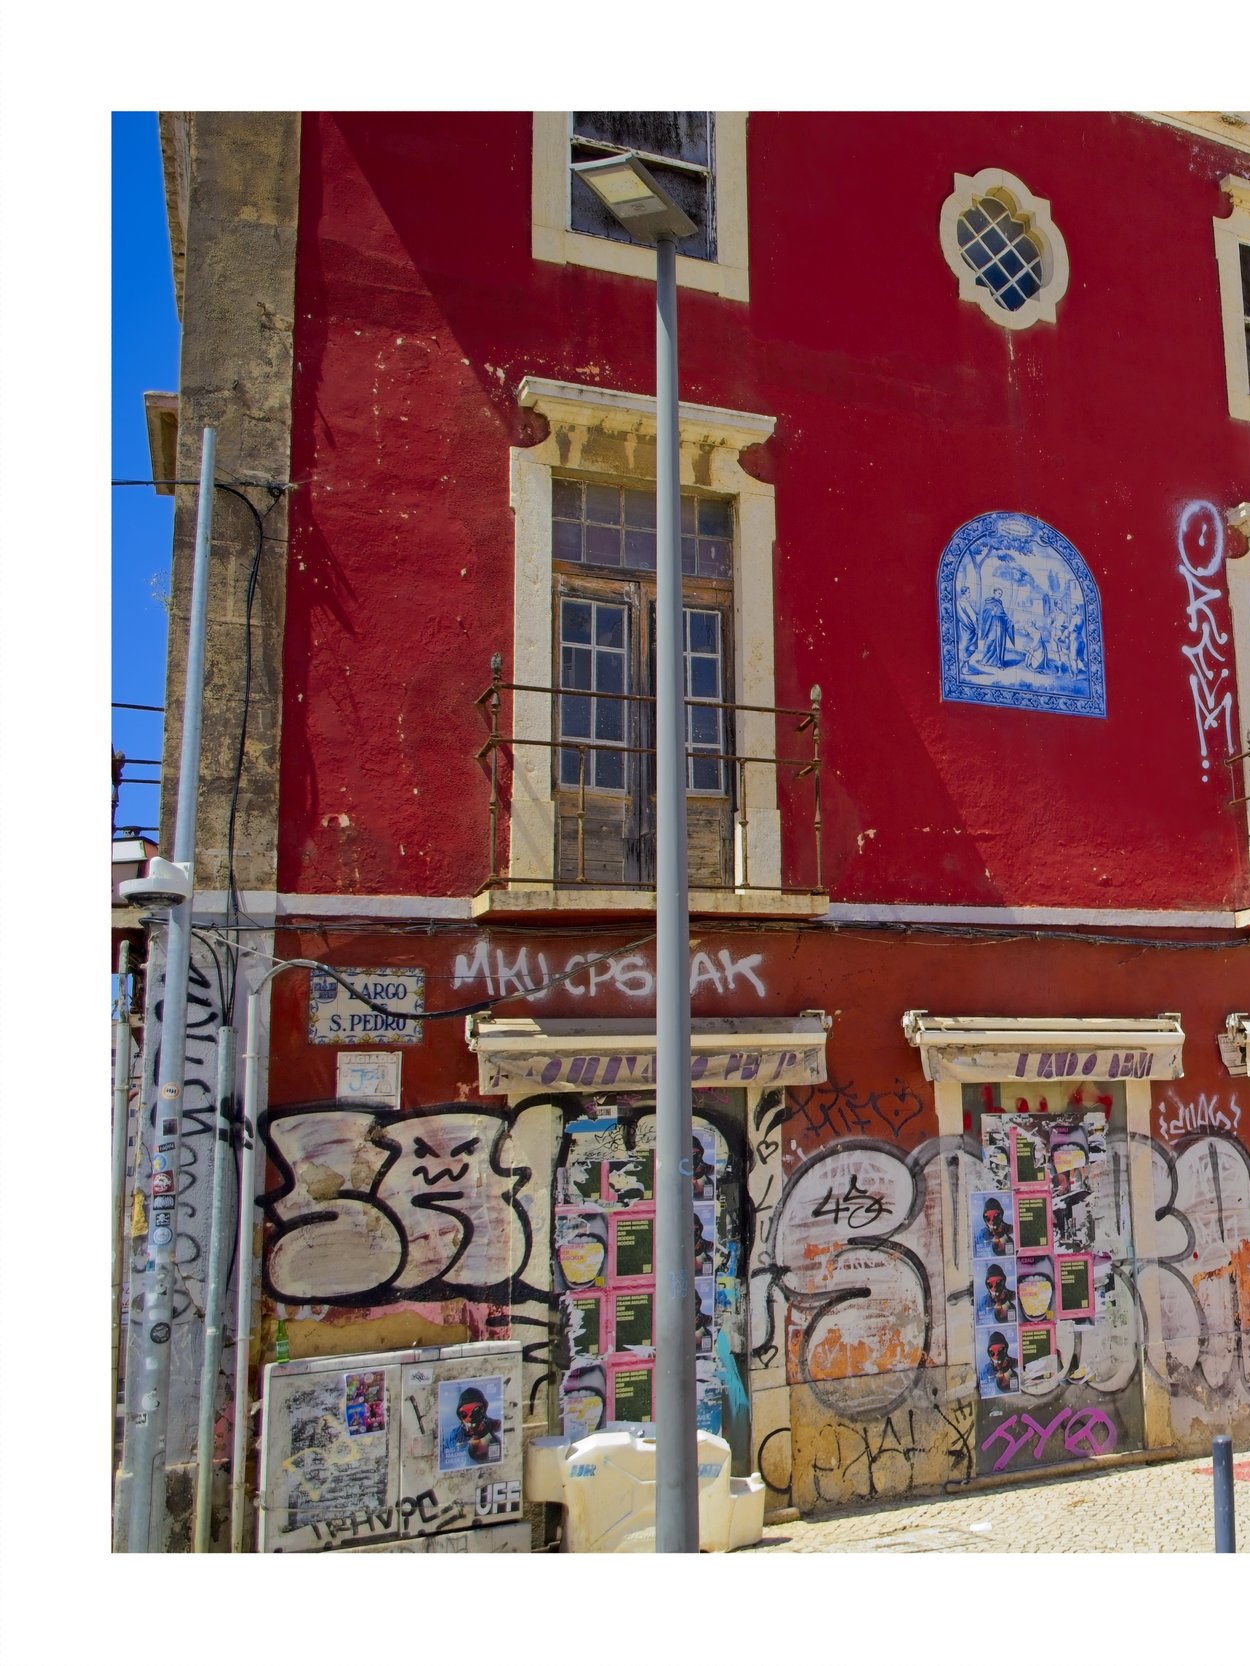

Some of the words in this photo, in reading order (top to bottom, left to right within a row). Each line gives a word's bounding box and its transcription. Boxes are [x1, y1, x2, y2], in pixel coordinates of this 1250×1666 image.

[348, 983, 408, 1001] LARGO
[350, 1013, 407, 1032] PEDRO
[475, 1480, 522, 1516] UFF
